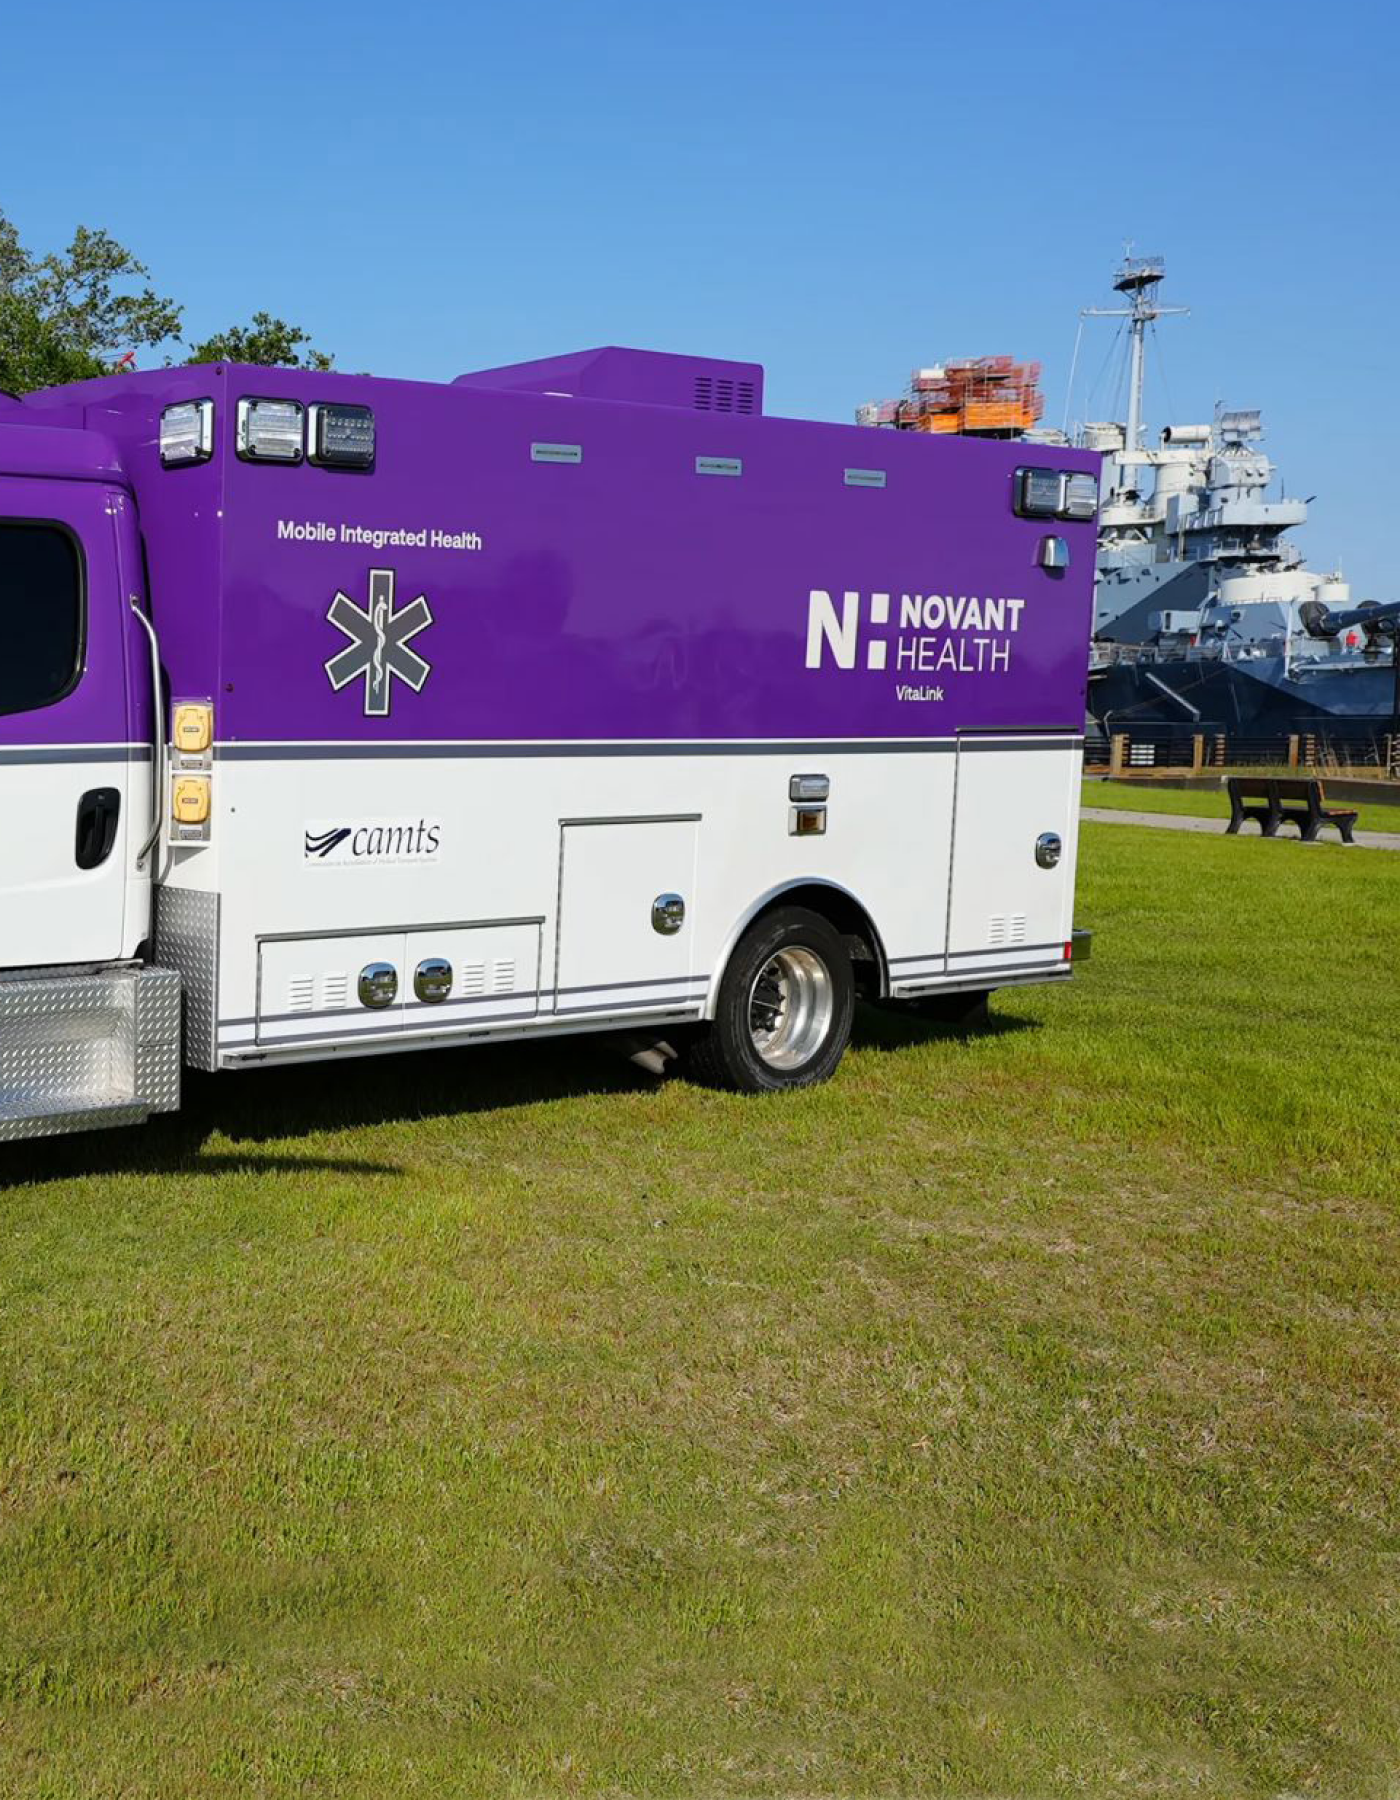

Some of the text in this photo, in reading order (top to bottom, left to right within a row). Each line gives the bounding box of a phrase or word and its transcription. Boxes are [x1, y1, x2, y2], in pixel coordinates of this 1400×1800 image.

[277, 520, 482, 551] Mobile Integrated Health
[899, 594, 1025, 632] NOVANT
[896, 636, 1011, 672] HEALTH
[895, 684, 945, 701] VitaLink
[352, 818, 441, 856] camts
